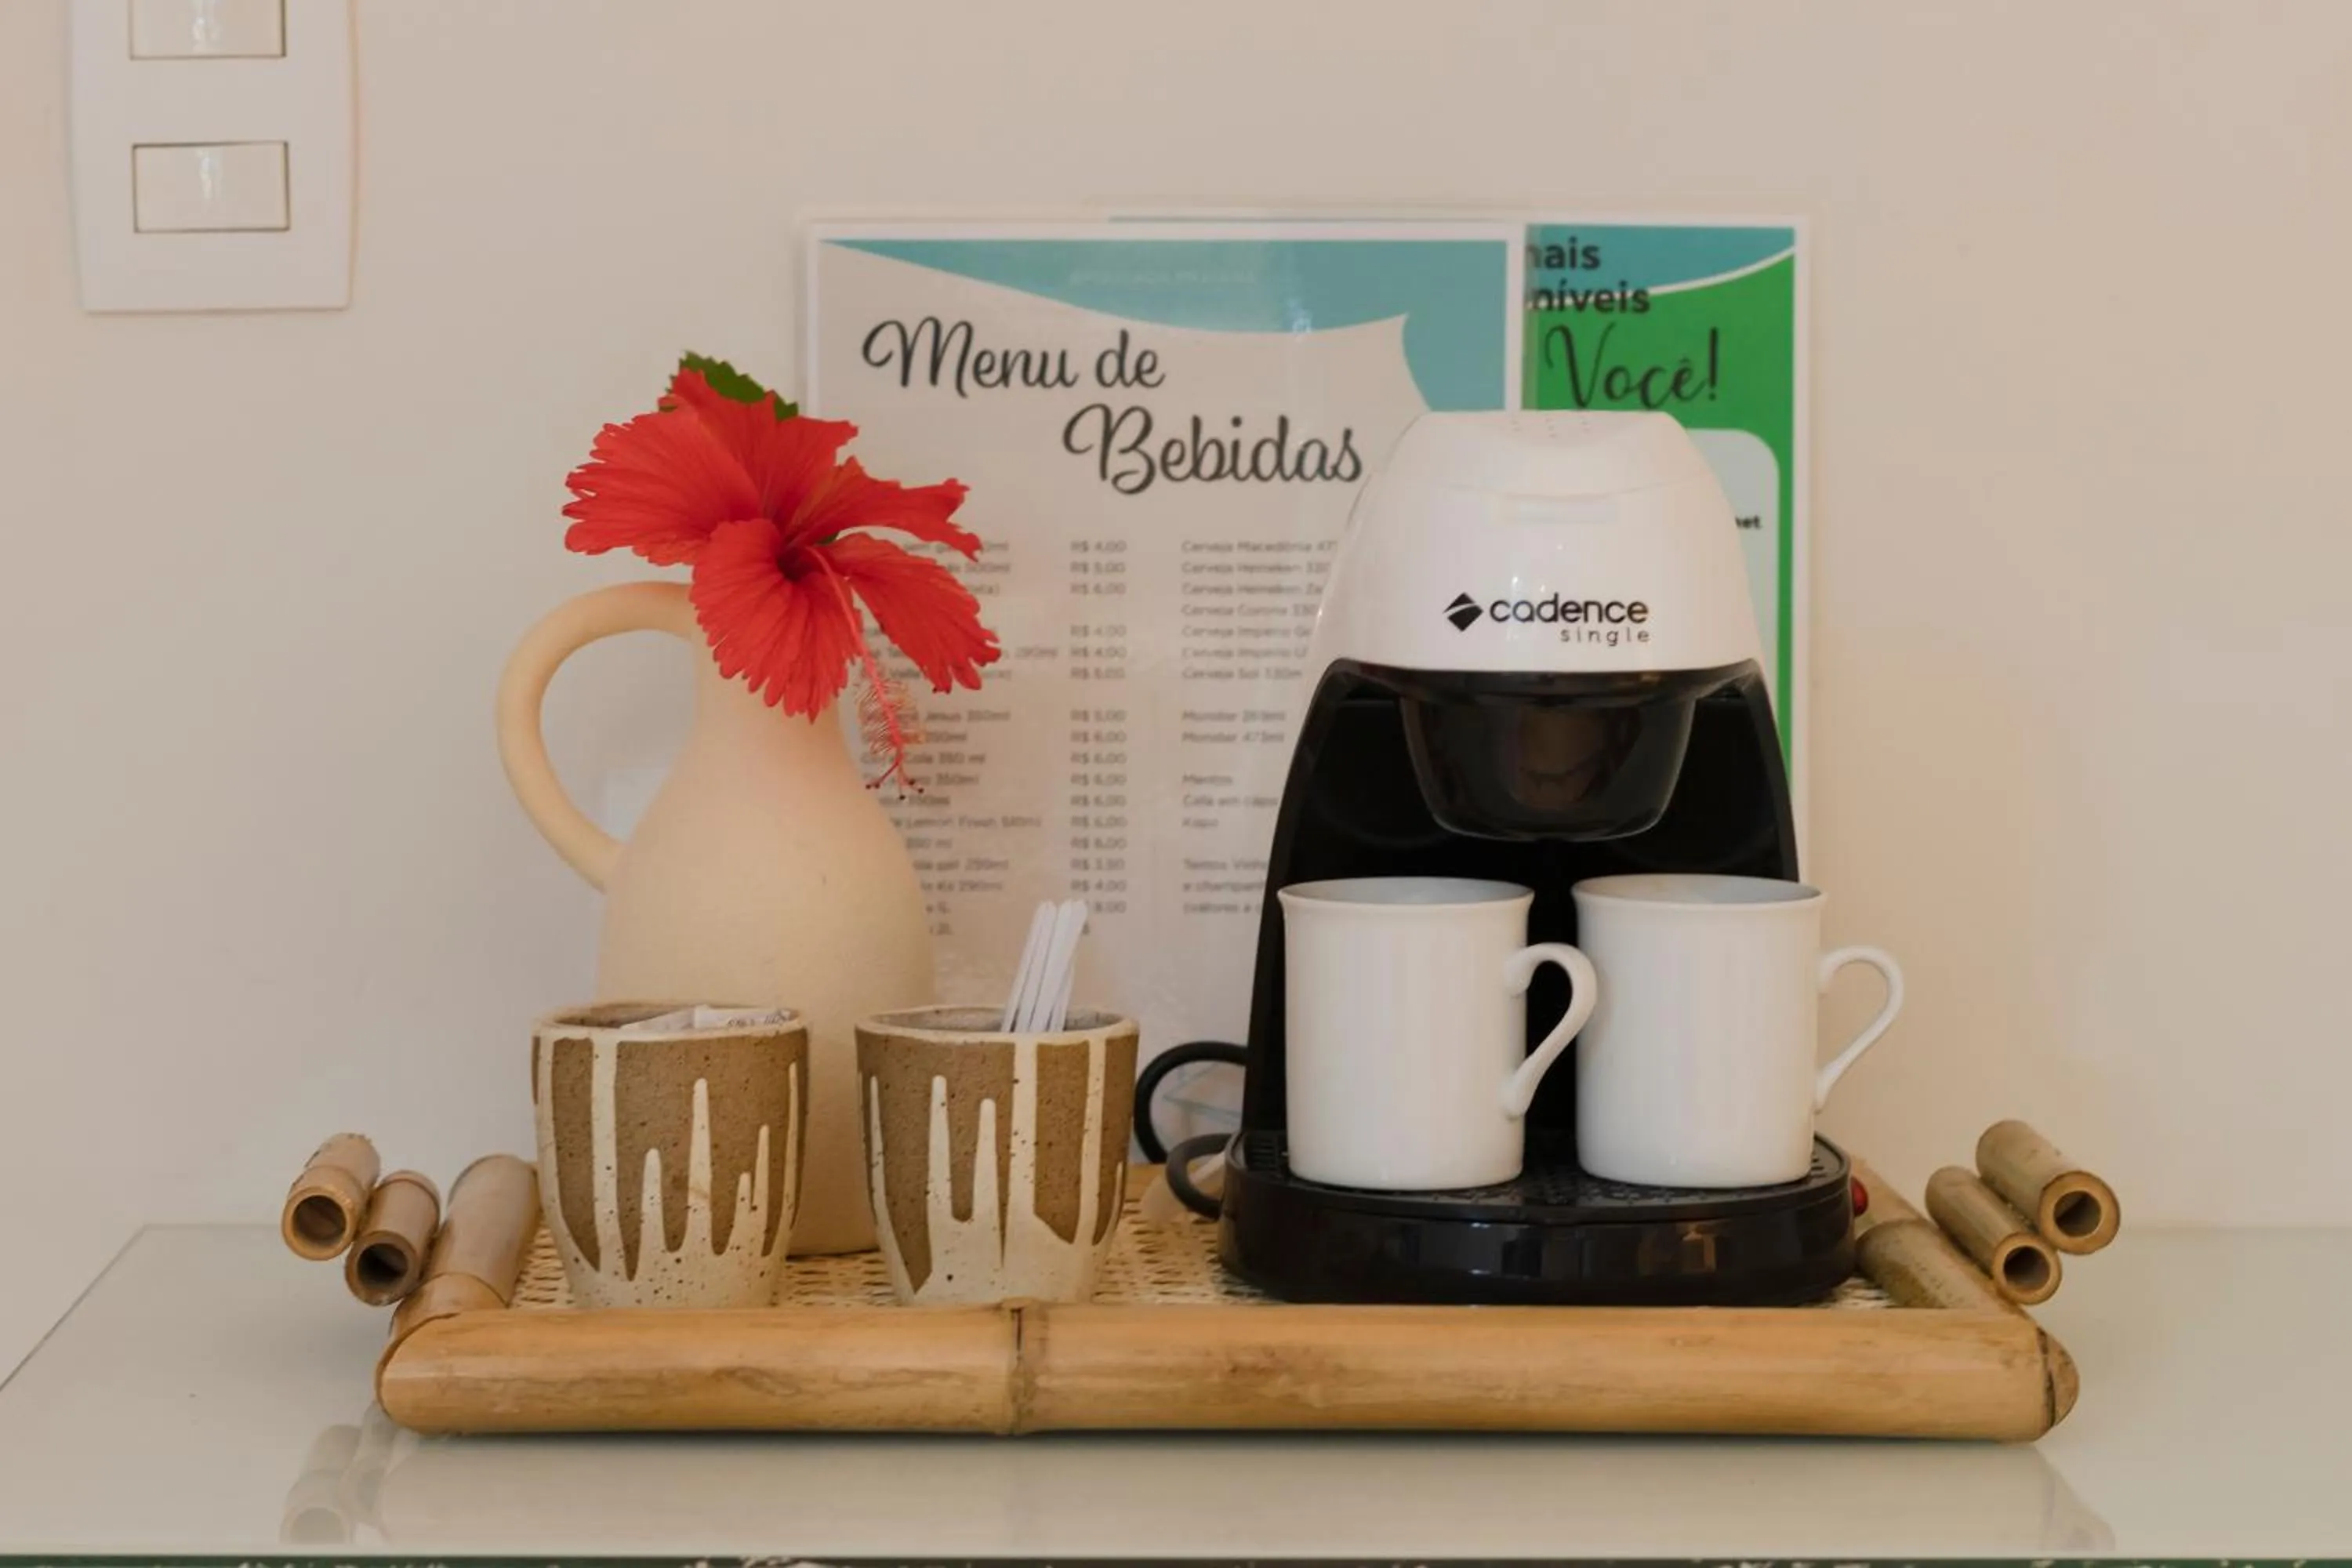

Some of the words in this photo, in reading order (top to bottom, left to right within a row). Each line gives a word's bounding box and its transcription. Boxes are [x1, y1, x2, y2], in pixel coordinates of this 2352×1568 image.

[862, 316, 1078, 398] Menu
[1096, 329, 1166, 388] de
[1544, 321, 1719, 408] Você!
[1063, 404, 1363, 493] Bebidas
[1490, 592, 1649, 623] cadence
[1560, 627, 1650, 646] single
